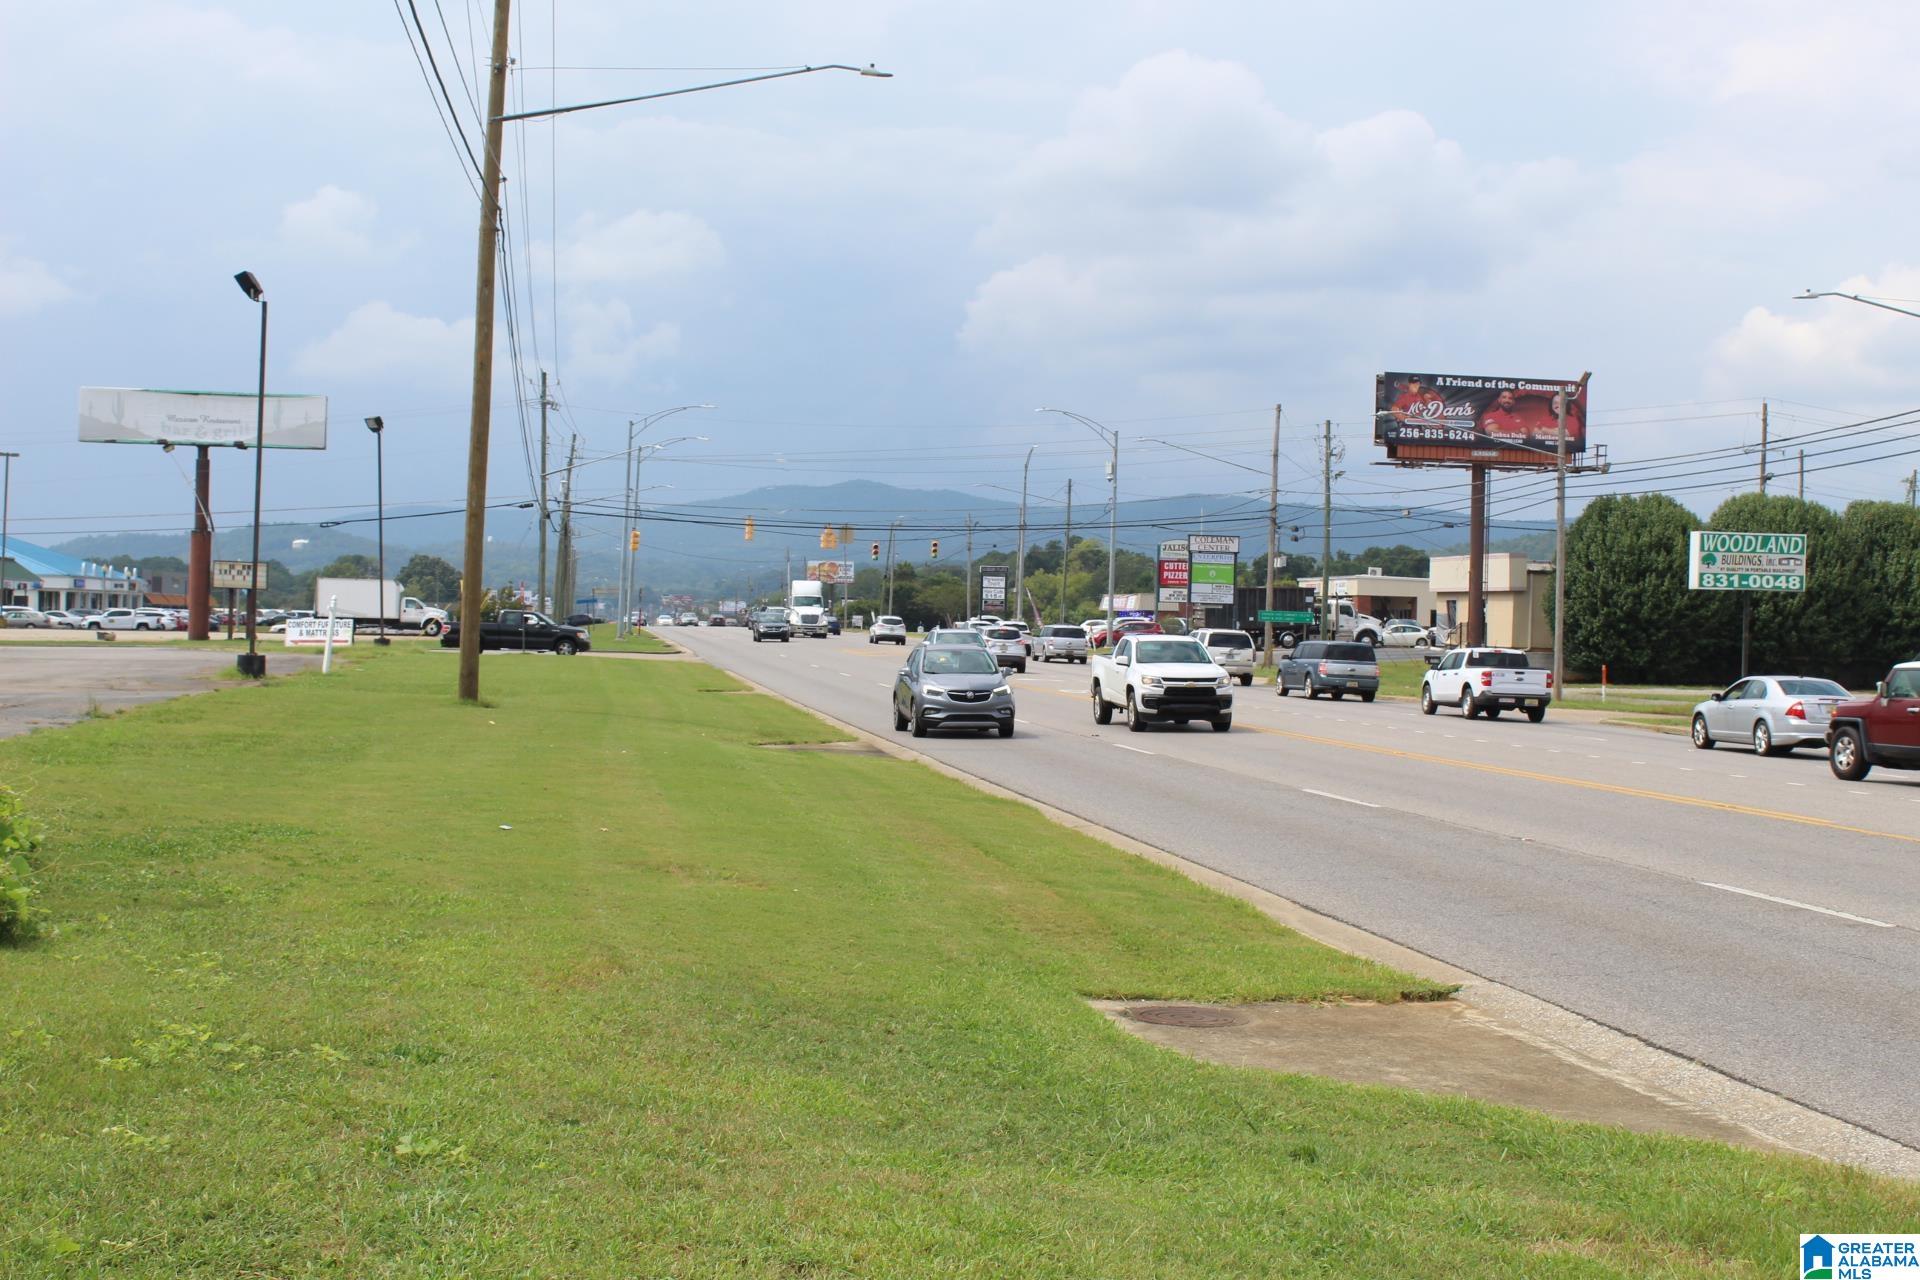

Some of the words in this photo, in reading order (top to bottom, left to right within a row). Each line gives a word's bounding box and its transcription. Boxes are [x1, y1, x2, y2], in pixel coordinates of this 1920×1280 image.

[1436, 377, 1444, 386] A
[1446, 378, 1482, 388] Friend
[1485, 380, 1496, 389] of
[1498, 381, 1516, 389] the
[1518, 382, 1577, 393] Commuit
[1400, 427, 1475, 441] 256-835-6244
[1194, 535, 1235, 545] COLEMAN
[1702, 534, 1802, 554] WOODLAND
[1197, 544, 1231, 552] CENTER
[1163, 571, 1188, 579] PIZZER
[1702, 574, 1801, 590] 831-0048
[288, 621, 317, 629] COMFORT
